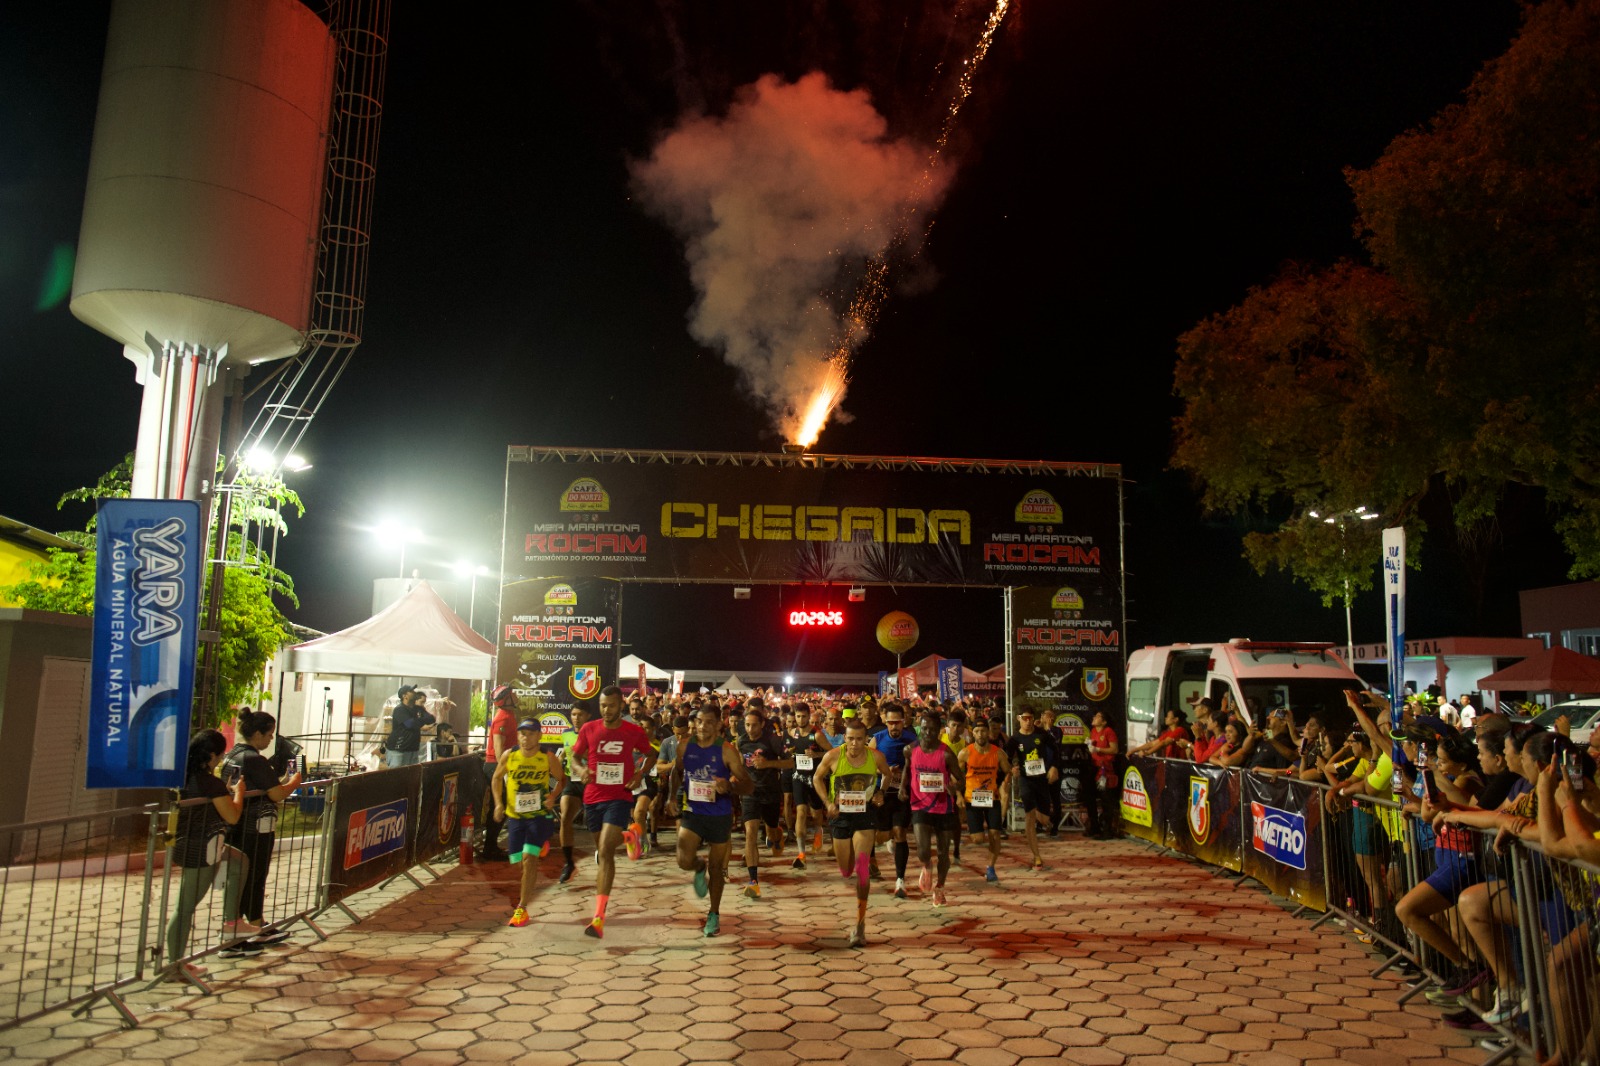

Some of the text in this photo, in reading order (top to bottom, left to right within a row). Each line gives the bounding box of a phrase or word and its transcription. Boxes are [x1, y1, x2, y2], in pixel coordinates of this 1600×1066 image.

[573, 484, 598, 492] CAFÉ
[568, 493, 603, 501] DO NORTE
[1027, 496, 1050, 504] CAFÉ
[1033, 505, 1055, 513] NORTE
[660, 501, 971, 545] CHEGADA
[567, 523, 641, 533] MARATONA
[525, 533, 647, 553] ROCAM
[991, 533, 1093, 545] MEIA MARATONA
[525, 553, 569, 562] PATRIMÔNIO
[600, 555, 647, 563] AMAZONENSE
[983, 543, 1101, 566] ROCAM
[984, 563, 1027, 571] PATRIMÔNIO
[132, 518, 186, 646] YARA
[512, 615, 606, 624] MEIA MARATONA
[1051, 619, 1112, 628] MARATONA
[504, 625, 612, 643] ROCAM
[1017, 628, 1119, 646] ROCAM
[106, 538, 130, 748] ÁGUA MINERAL NATURAL
[537, 653, 577, 662] REALIZAÇÃO:
[1049, 656, 1087, 664] REALIZAÇÃO:
[947, 665, 960, 698] YARA
[963, 682, 992, 690] EDALHAS
[1052, 703, 1089, 711] PATROCÍNIO:
[542, 718, 564, 726] CAFÉ
[1057, 719, 1079, 727] CAFÉ
[600, 770, 620, 778] 7166
[841, 799, 865, 807] 21192
[348, 812, 405, 855] FAMETRO
[1253, 814, 1305, 856] FAMETRO
